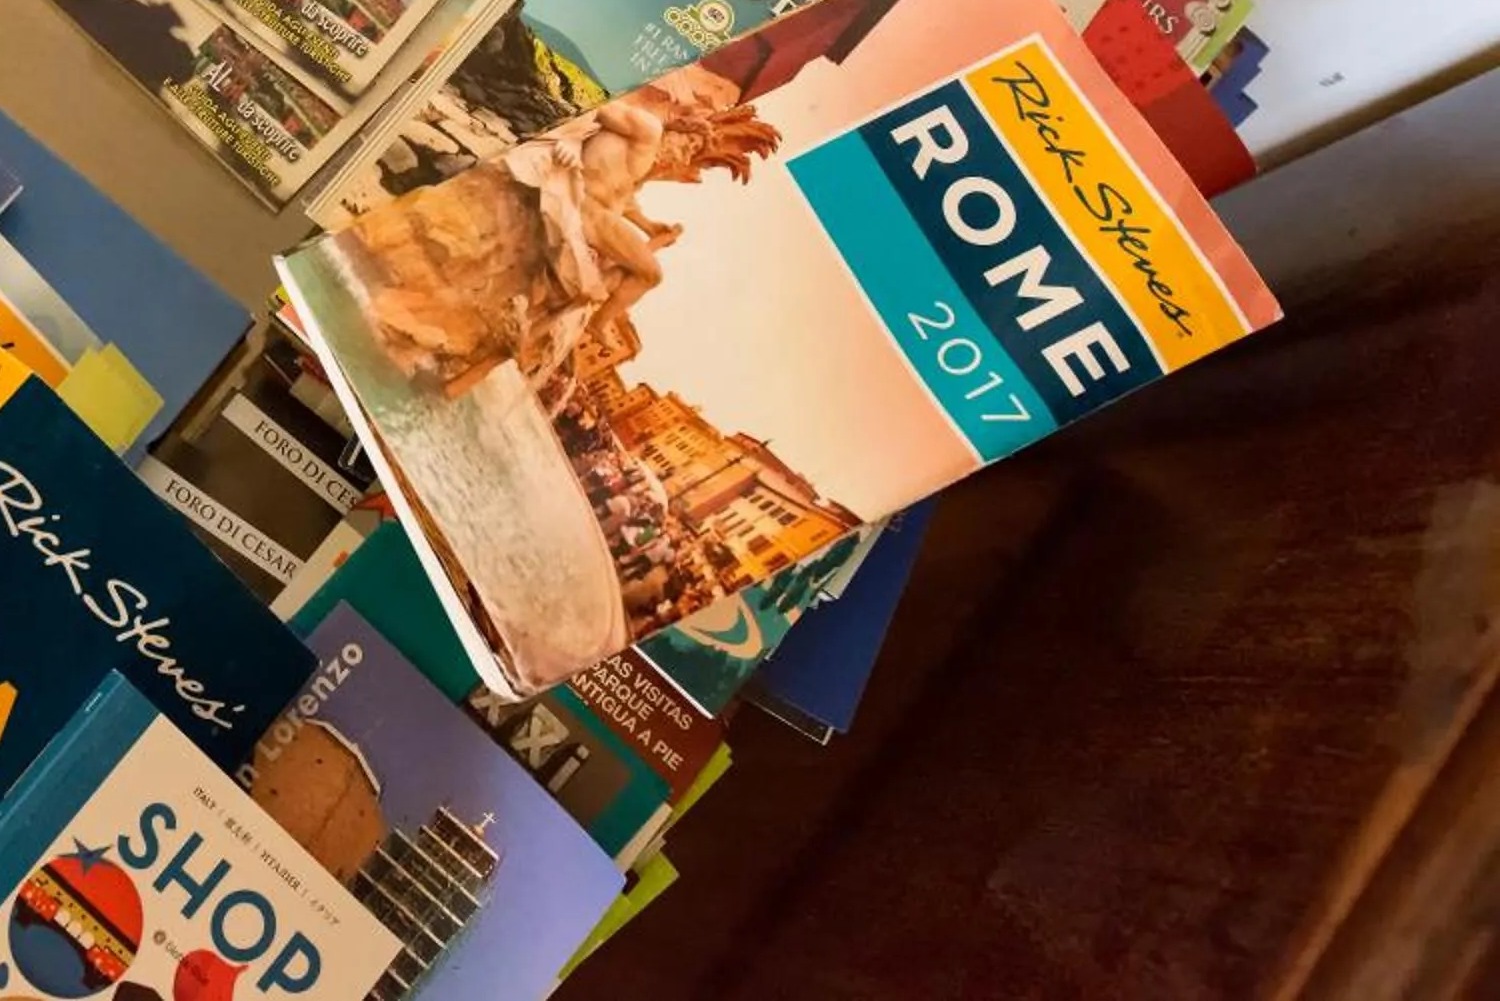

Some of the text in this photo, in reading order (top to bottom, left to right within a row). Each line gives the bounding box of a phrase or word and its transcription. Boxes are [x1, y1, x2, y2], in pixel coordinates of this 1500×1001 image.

[316, 13, 370, 59] scoprire
[889, 104, 1132, 399] ROME
[991, 60, 1194, 338] Rick Steves
[906, 301, 1033, 422] 2017
[253, 419, 303, 465] FORO
[301, 460, 328, 486] DI
[163, 478, 298, 581] FORO DI CESAR
[256, 641, 365, 763] Lorenzo
[632, 671, 694, 731] VISITAS
[636, 730, 653, 747] A
[650, 740, 686, 773] PIE
[116, 802, 323, 995] SHOP
